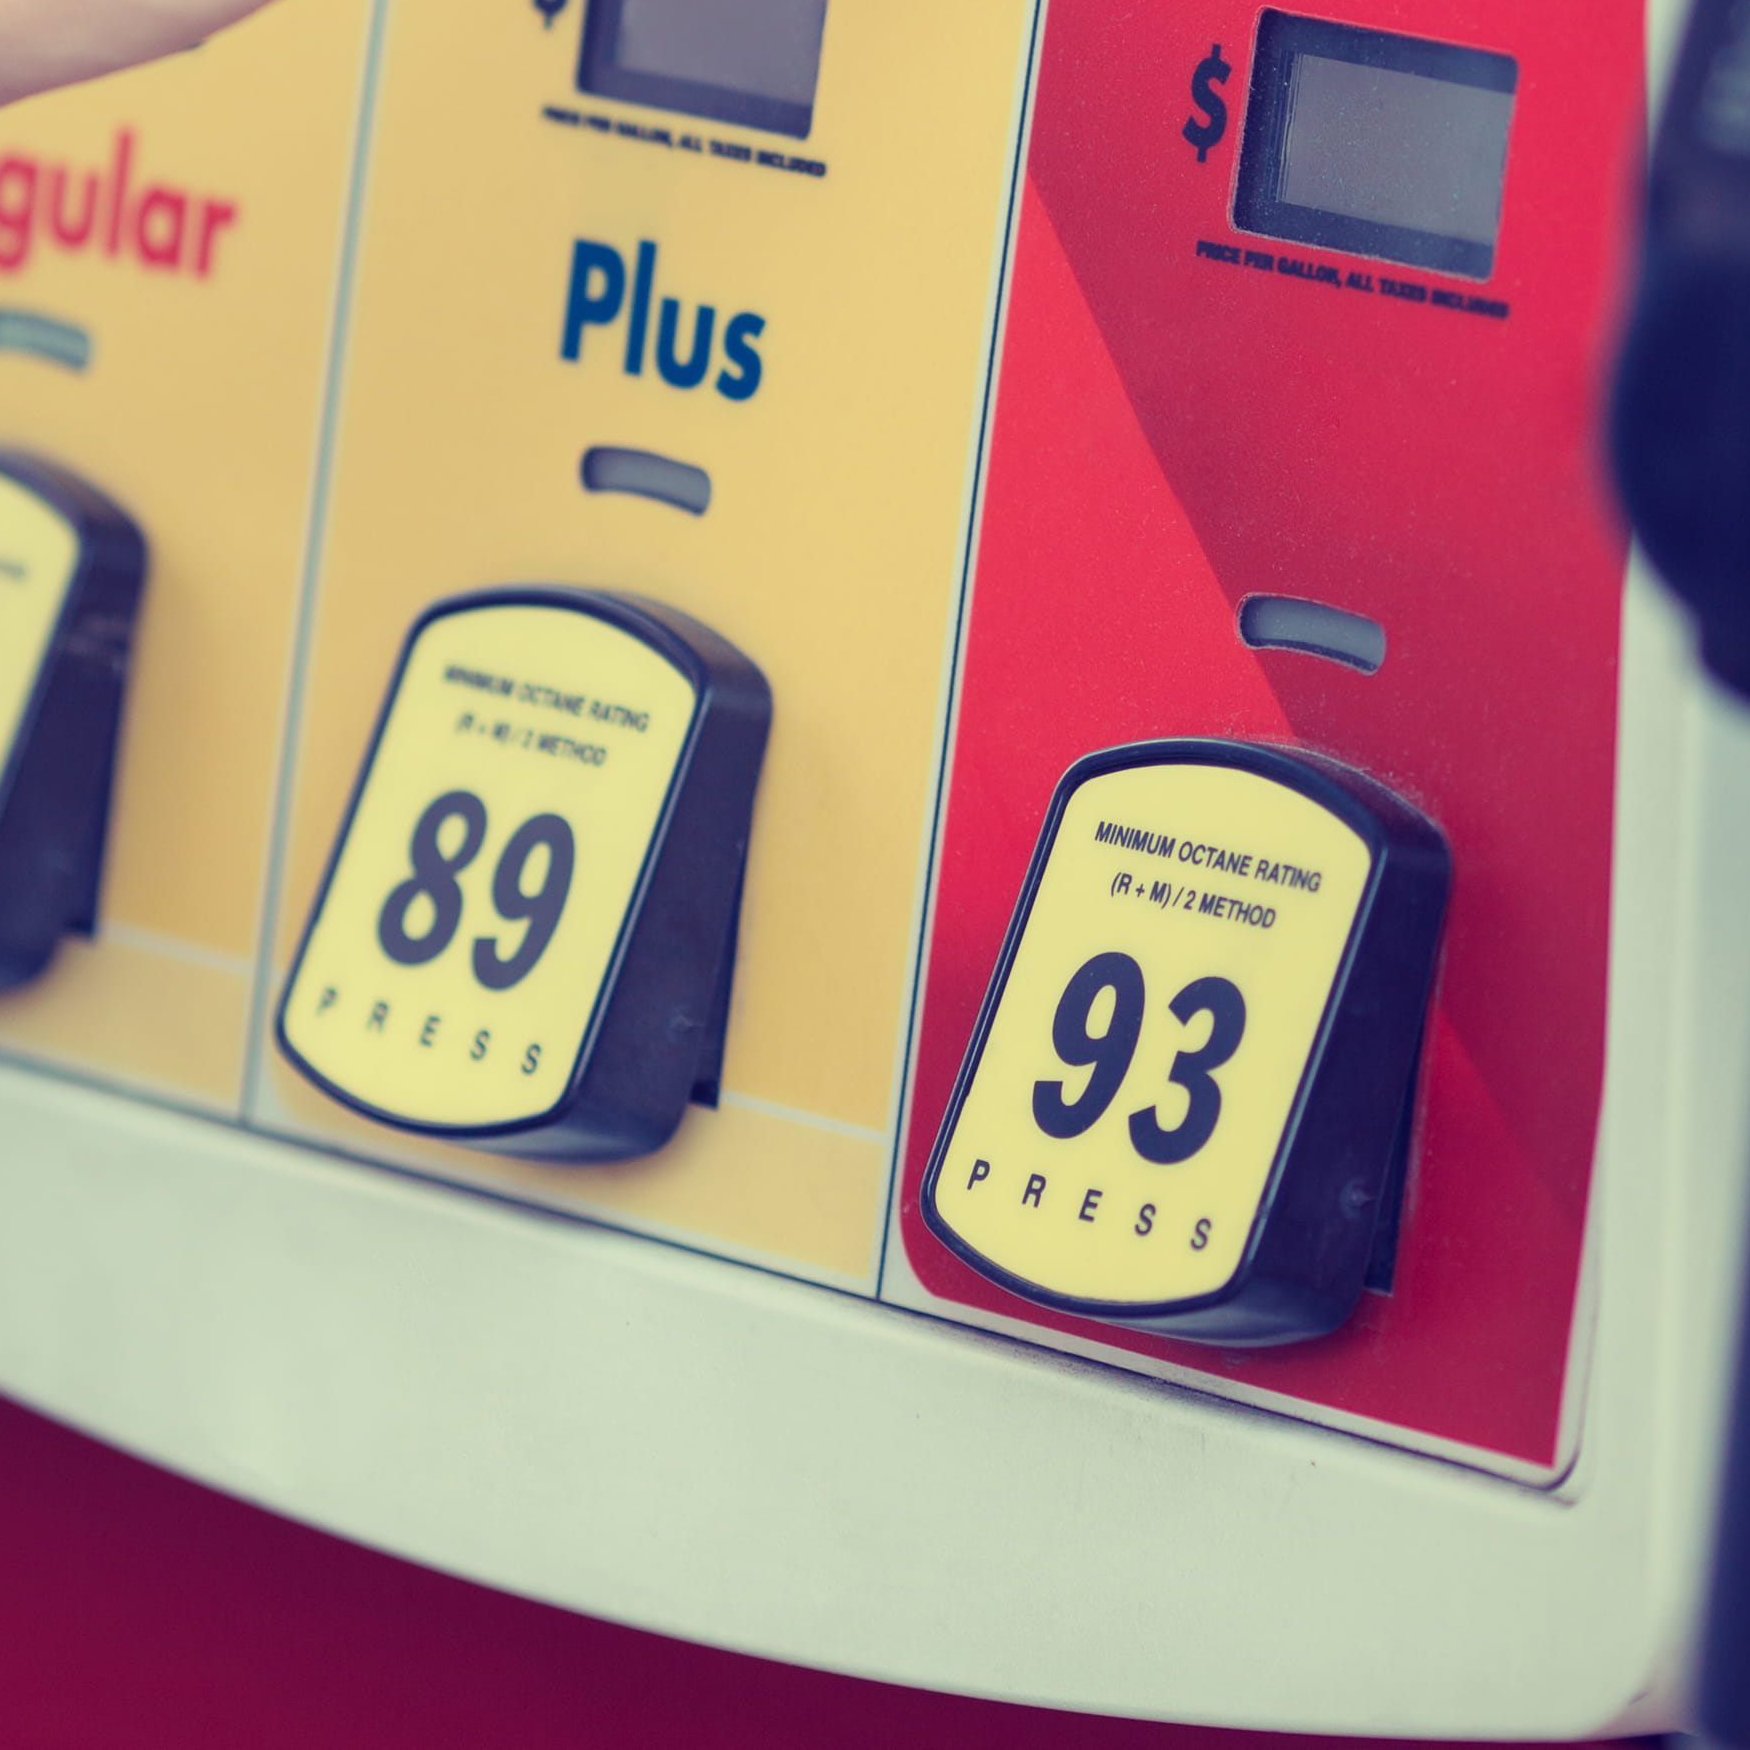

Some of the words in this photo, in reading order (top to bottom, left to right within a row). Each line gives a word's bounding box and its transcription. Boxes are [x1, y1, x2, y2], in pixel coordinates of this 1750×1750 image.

[1182, 43, 1232, 163] $
[1195, 239, 1242, 266] PRICE
[1243, 249, 1275, 273] PER
[1277, 257, 1343, 289] GALLON,
[1345, 270, 1375, 294] ALL
[559, 235, 767, 405] Plus
[517, 682, 586, 718] OCTANE
[589, 699, 650, 733] RATING
[536, 731, 608, 768] METHOD
[376, 789, 576, 993] 89
[1094, 820, 1176, 860] MINIMUM
[1178, 841, 1253, 877] OCTANE
[1254, 859, 1323, 894] RATING
[1110, 871, 1134, 898] (R
[1148, 881, 1173, 911] M)
[1182, 889, 1197, 911] 2
[1197, 892, 1277, 930] METHOD
[317, 986, 542, 1077] PRESS
[1031, 950, 1247, 1165] 93
[966, 1158, 1212, 1251] PRESS
